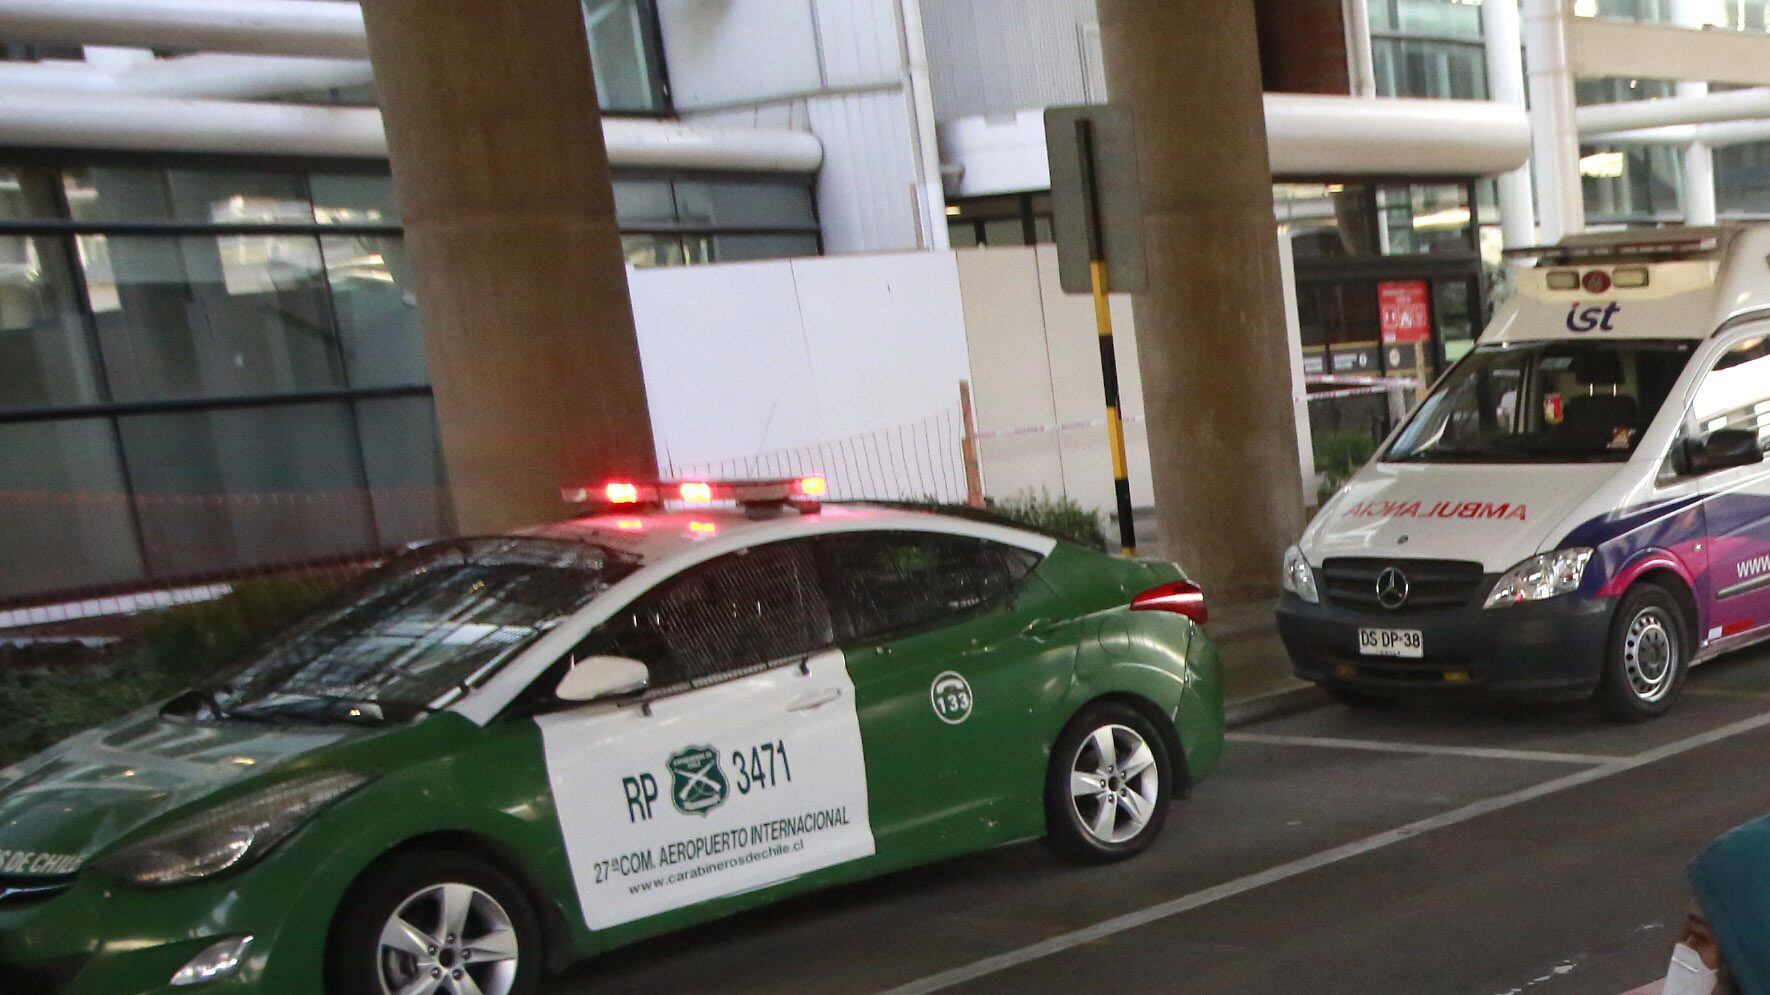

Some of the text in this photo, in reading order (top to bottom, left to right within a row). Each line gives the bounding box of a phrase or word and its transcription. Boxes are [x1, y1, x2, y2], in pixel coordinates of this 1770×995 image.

[1566, 301, 1621, 332] ist
[1360, 629, 1378, 647] DS
[936, 691, 970, 715] 133
[622, 739, 792, 824] RP 3471
[659, 827, 748, 867] AEROPUERTO
[750, 805, 850, 847] INTERNACIONAL
[628, 838, 806, 895] www.carabinerosdechile.cl
